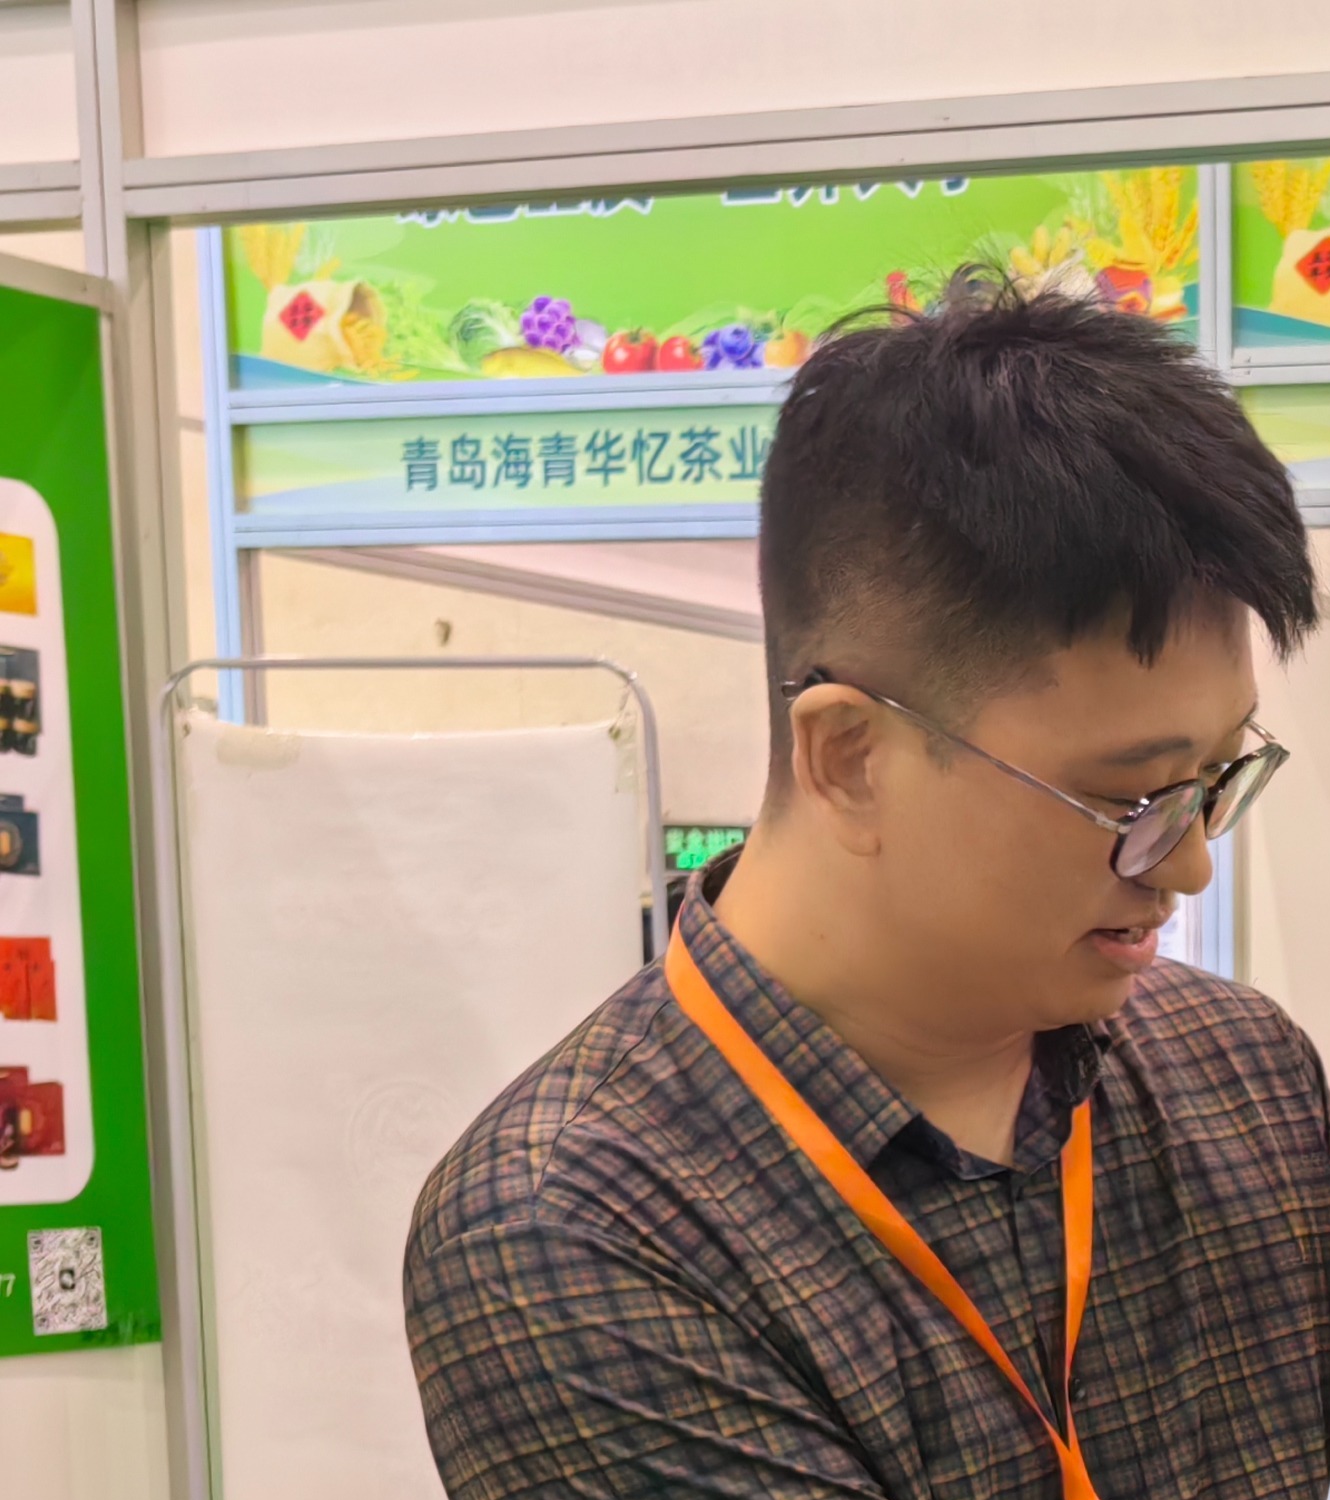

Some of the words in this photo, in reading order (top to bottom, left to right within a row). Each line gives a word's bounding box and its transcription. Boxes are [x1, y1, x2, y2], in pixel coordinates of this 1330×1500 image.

[400, 426, 768, 491] 青岛海青华忆茶业
